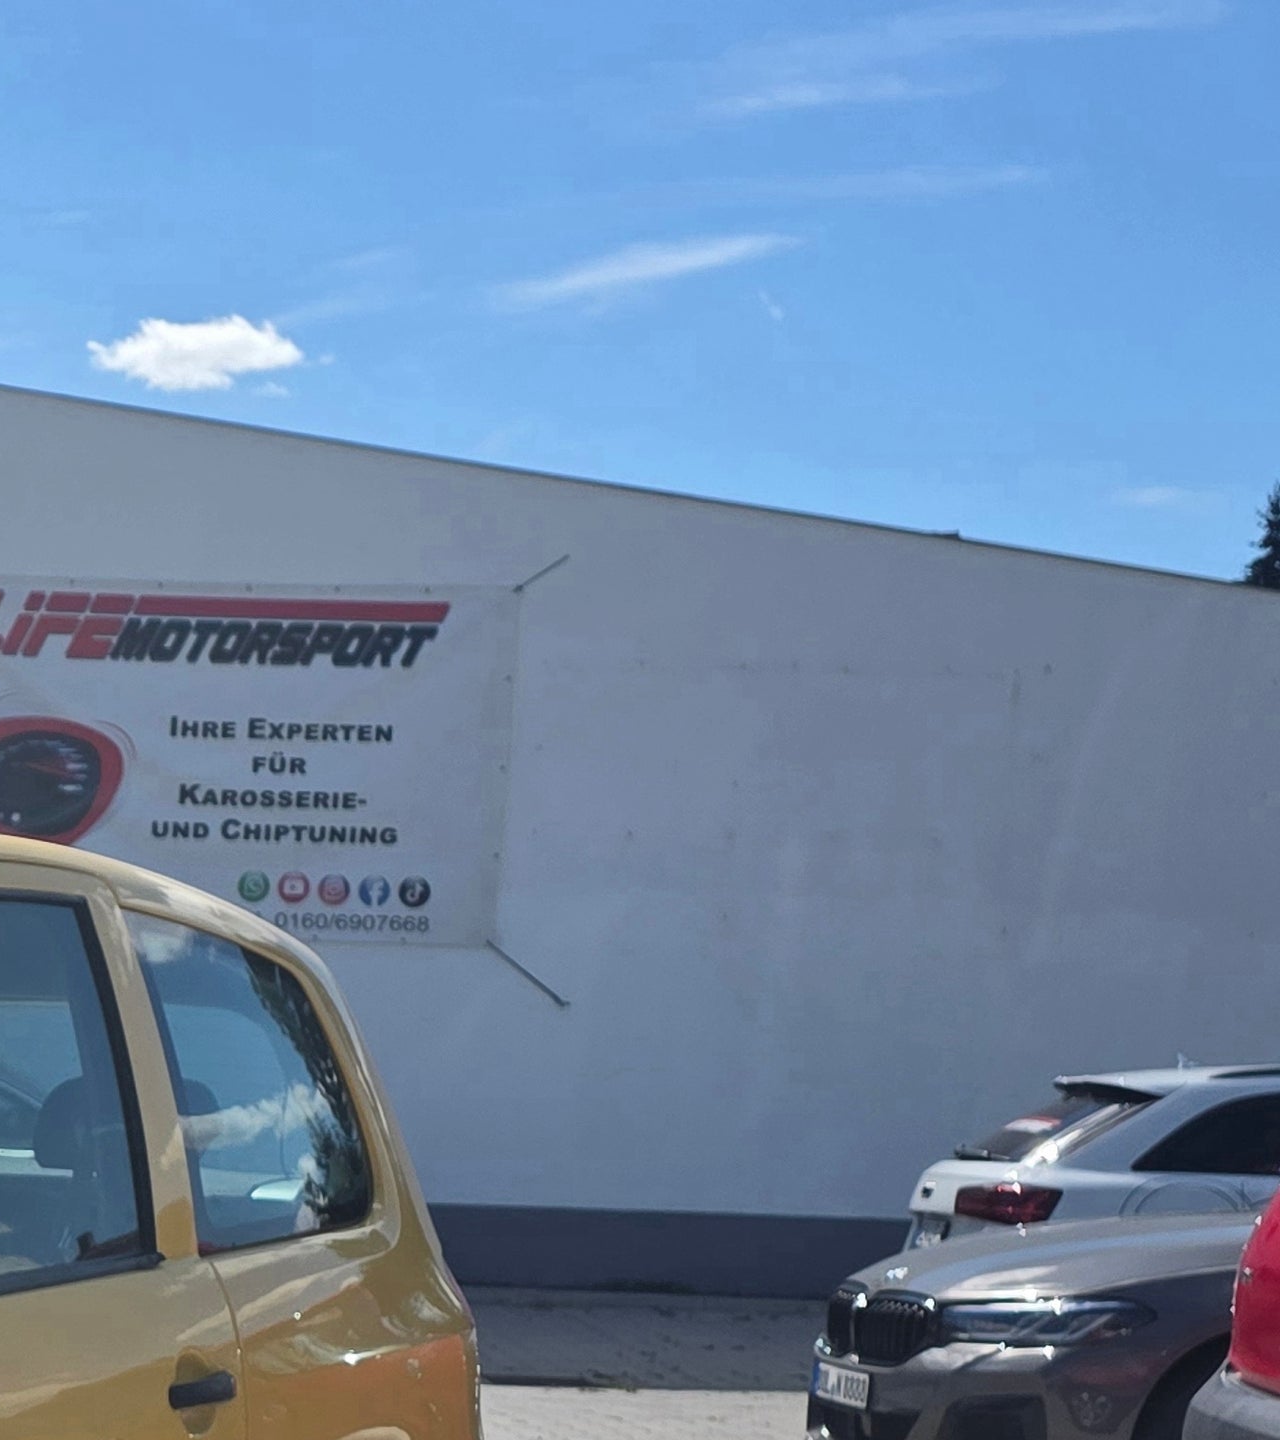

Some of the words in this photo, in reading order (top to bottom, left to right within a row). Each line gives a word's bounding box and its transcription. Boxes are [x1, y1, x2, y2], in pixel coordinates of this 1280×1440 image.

[169, 715, 237, 739] IHRE
[247, 717, 394, 743] EXPERTEN
[251, 751, 307, 775] FÜR
[178, 783, 367, 810] KAROSSERIE-
[151, 820, 210, 839] UND
[220, 818, 399, 845] CHIPTUNING
[274, 910, 430, 933] 0160/6907668
